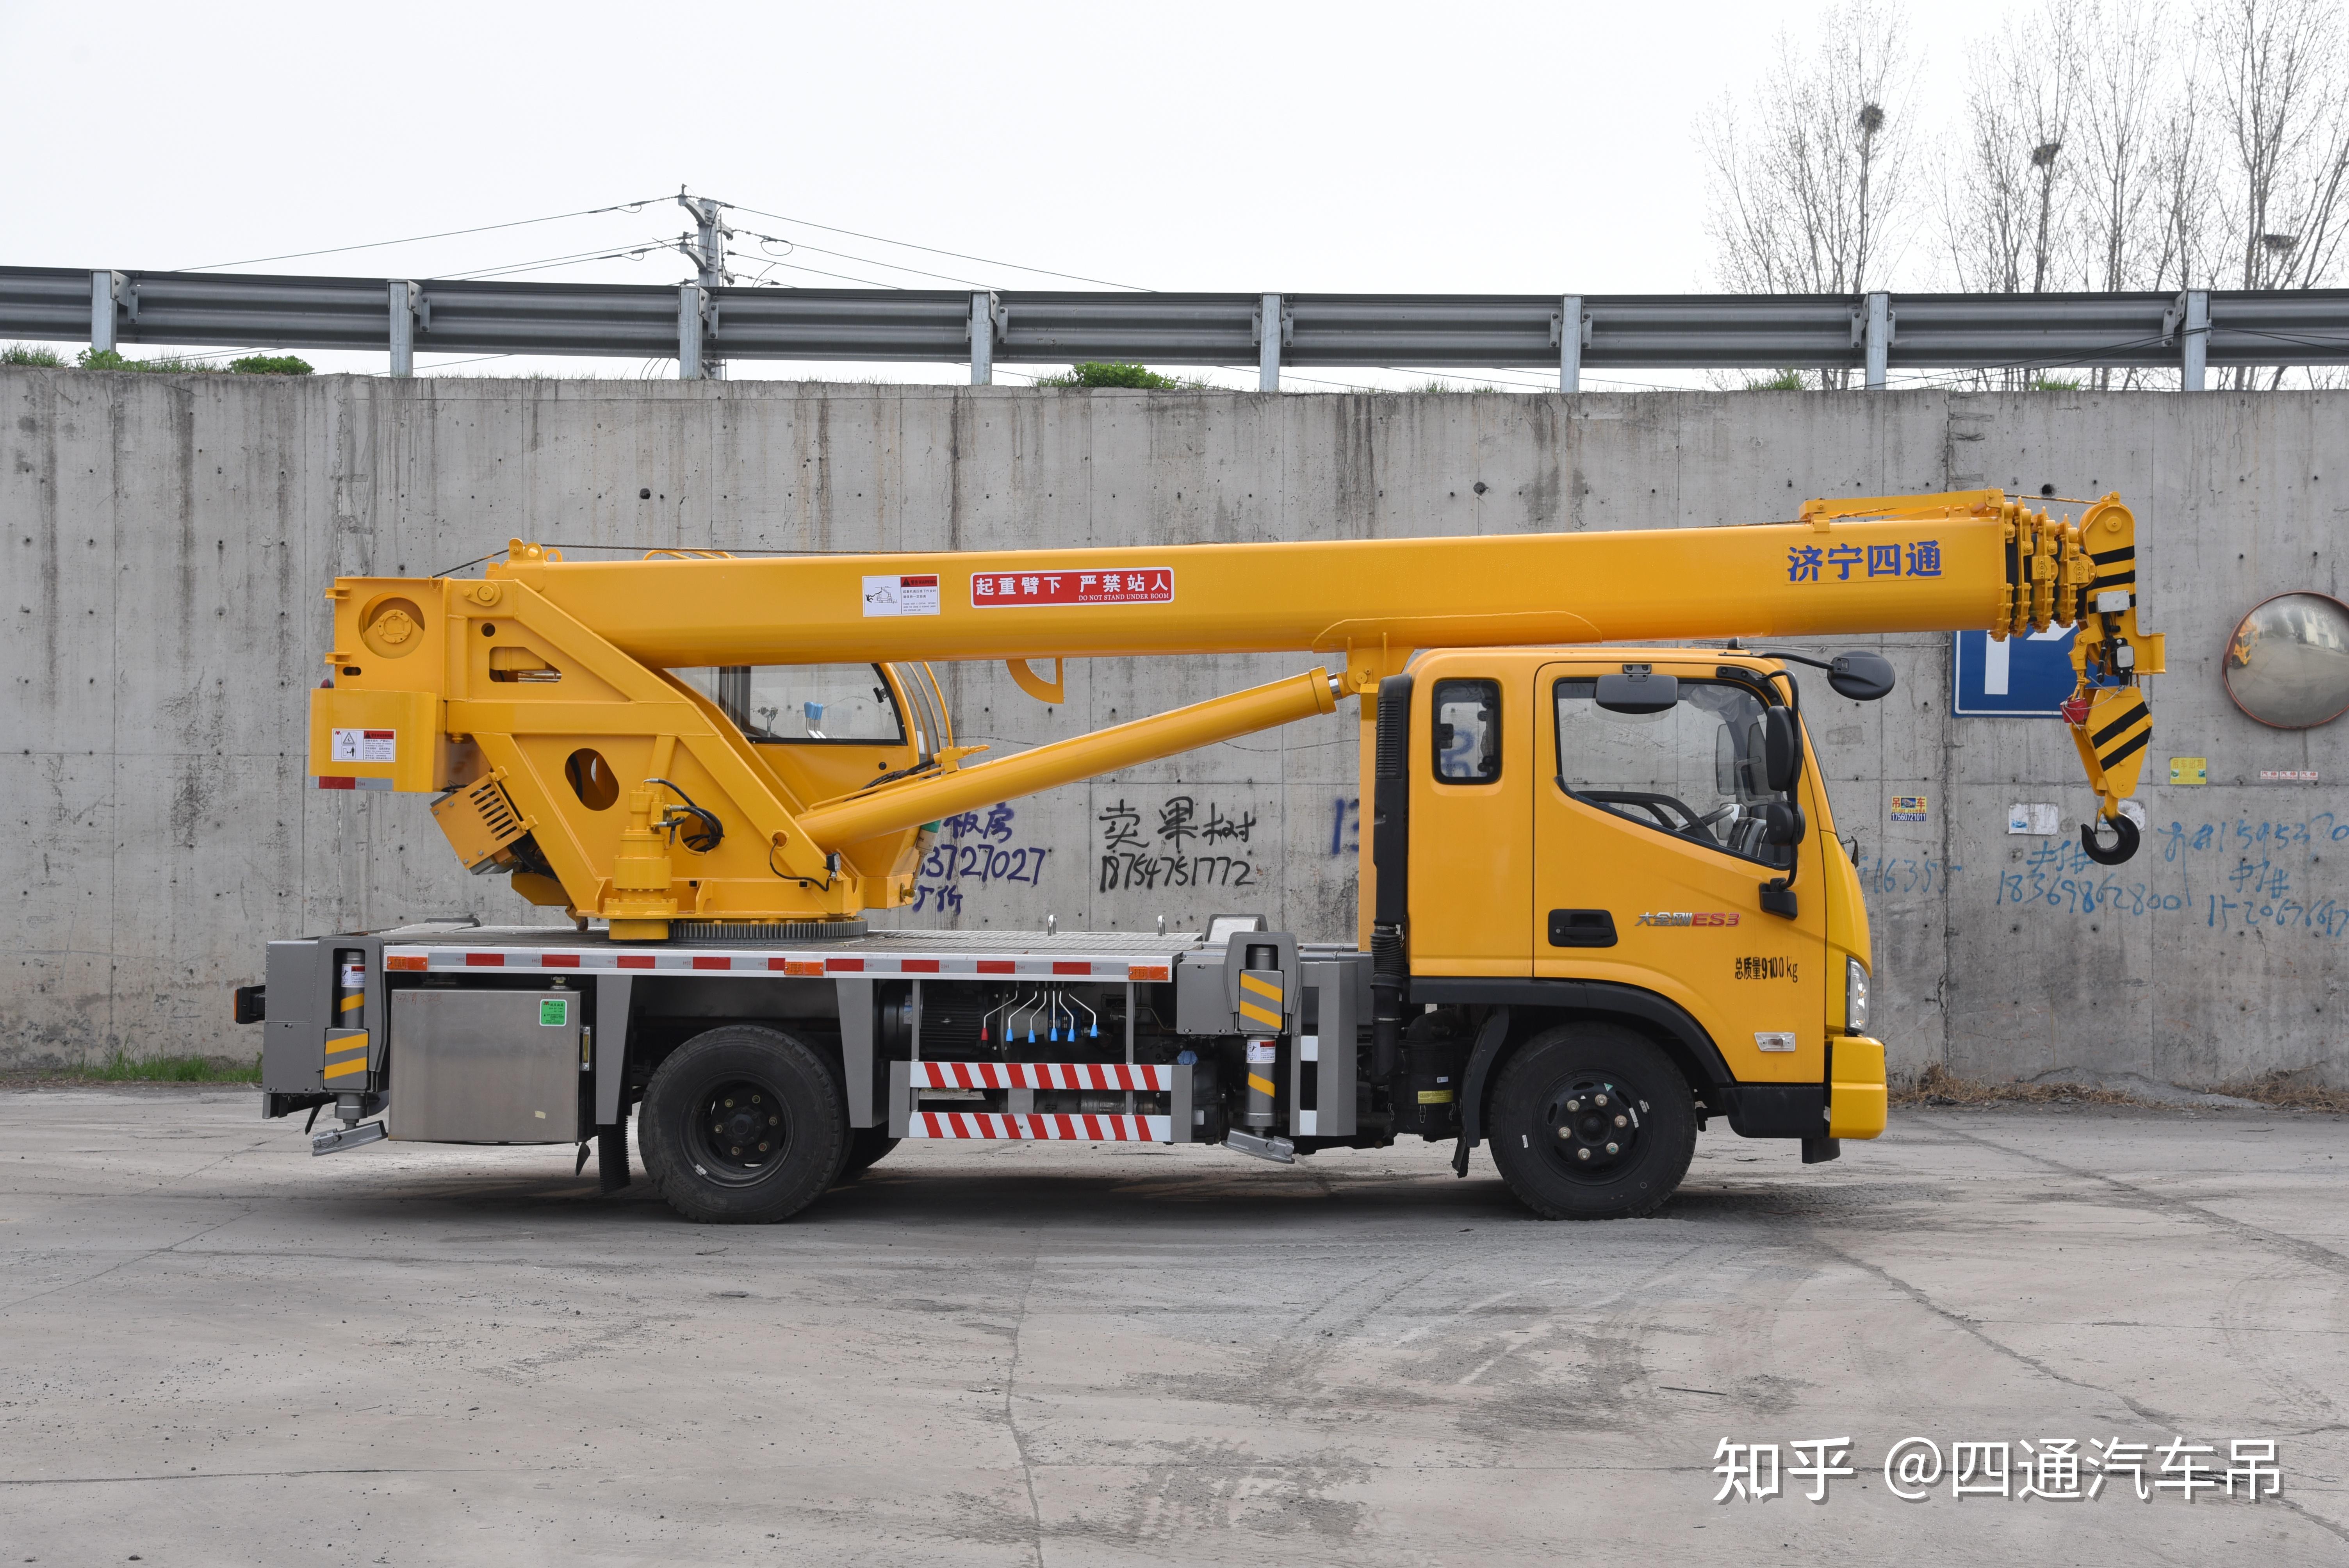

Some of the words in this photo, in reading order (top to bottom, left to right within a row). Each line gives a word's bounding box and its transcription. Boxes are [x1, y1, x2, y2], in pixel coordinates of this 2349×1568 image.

[1787, 540, 1942, 582] 济宁四通
[976, 576, 1062, 596] 起重臂下
[1080, 573, 1169, 593] 严禁站人
[1892, 797, 1900, 809] 吊
[1916, 797, 1925, 809] 车
[1891, 813, 1926, 821] 17560721011
[1100, 853, 1255, 893] 18754751772
